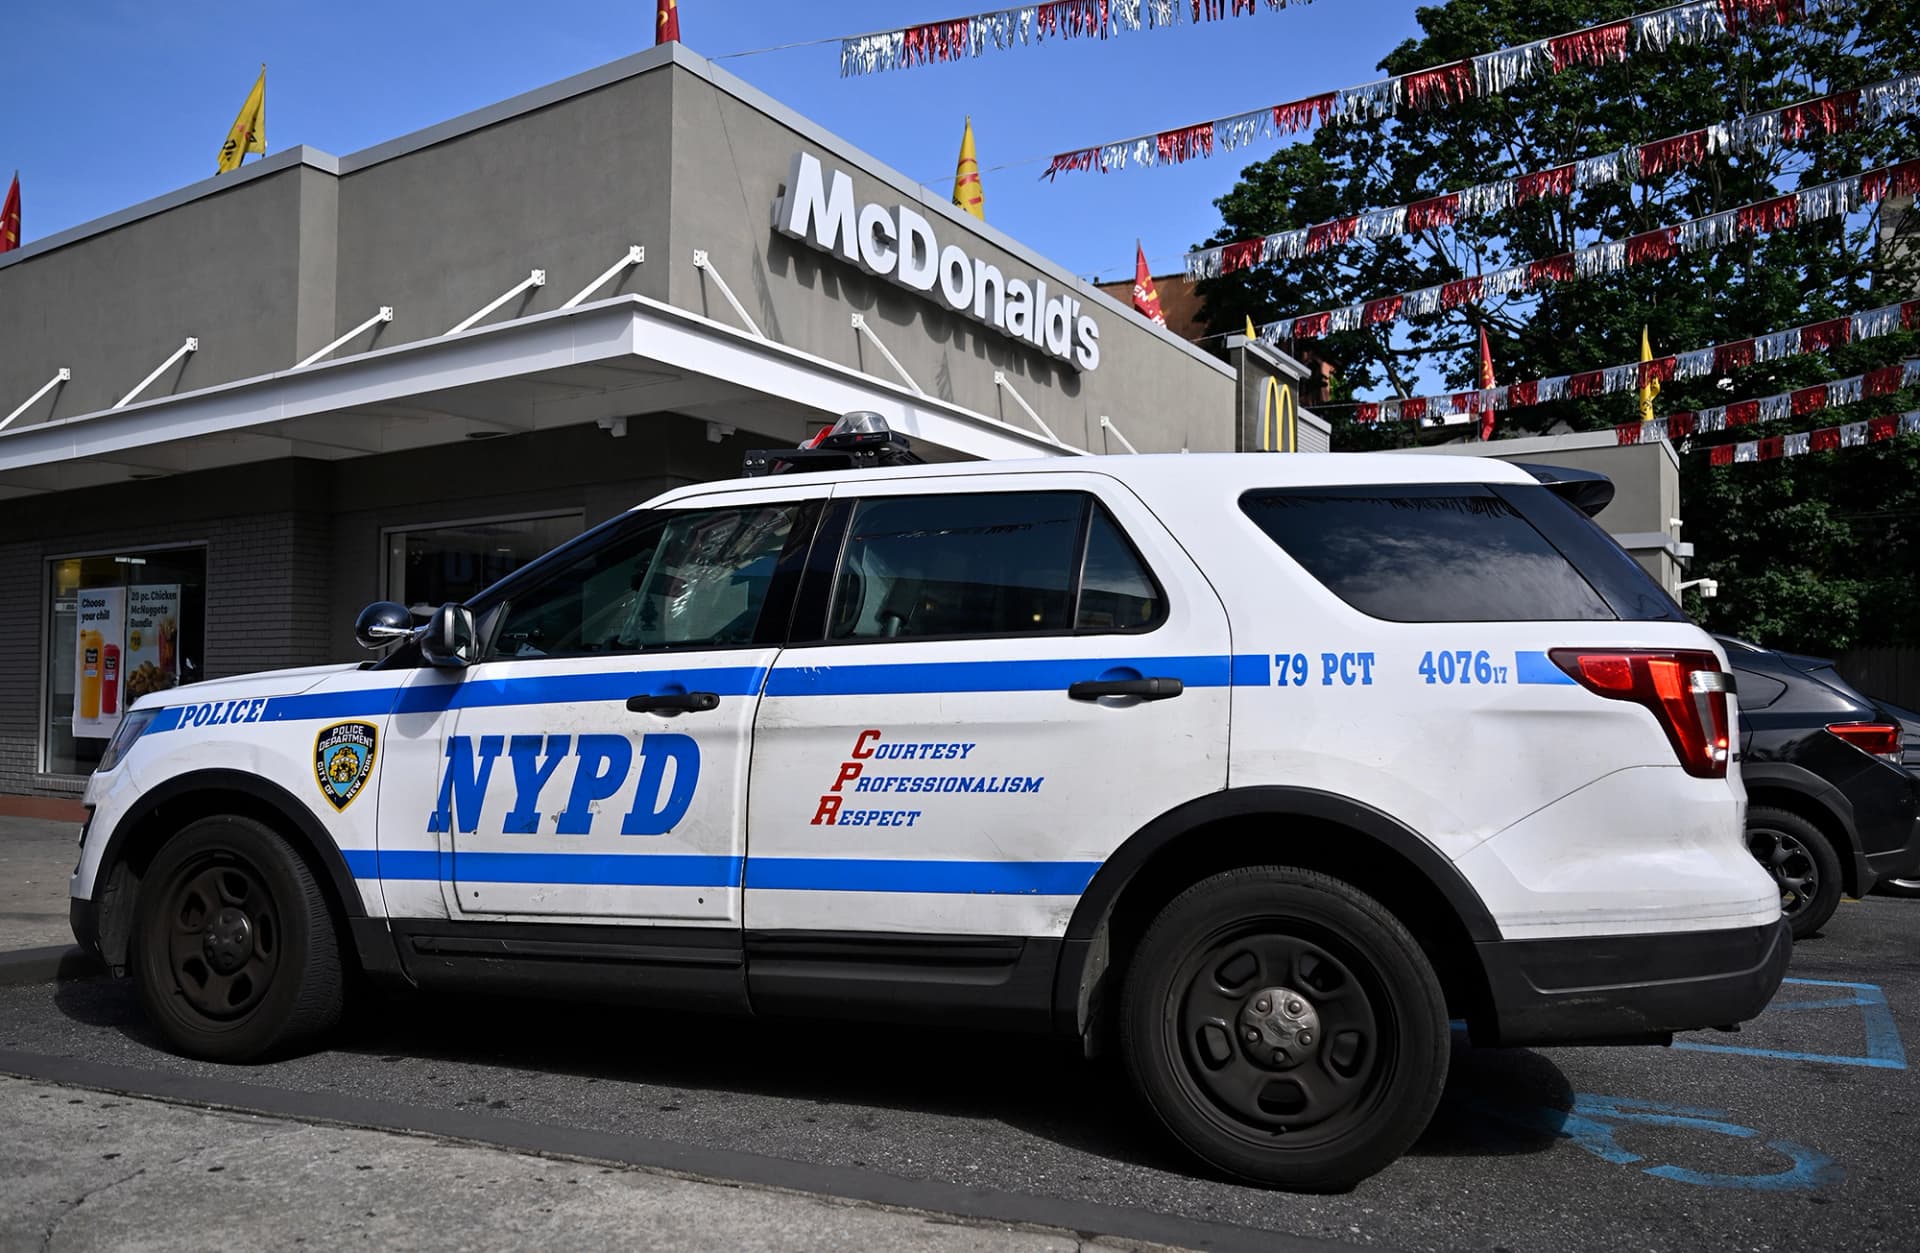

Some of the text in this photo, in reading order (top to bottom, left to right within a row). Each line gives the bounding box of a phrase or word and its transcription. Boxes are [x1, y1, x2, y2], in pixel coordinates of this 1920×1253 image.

[788, 151, 1100, 371] McDonald's
[82, 599, 105, 608] Choose
[151, 591, 177, 600] Chicken
[81, 610, 110, 623] your chill
[131, 605, 168, 616] McNuggets
[130, 618, 153, 628] Bundle
[1273, 651, 1376, 687] 79 PCT
[178, 698, 266, 730] POLICE
[332, 725, 365, 737] POLICE
[318, 734, 374, 752] DEPARTMENT
[317, 761, 335, 796] CITY OF
[346, 753, 373, 800] NEW YORK
[428, 733, 701, 835] NYPD
